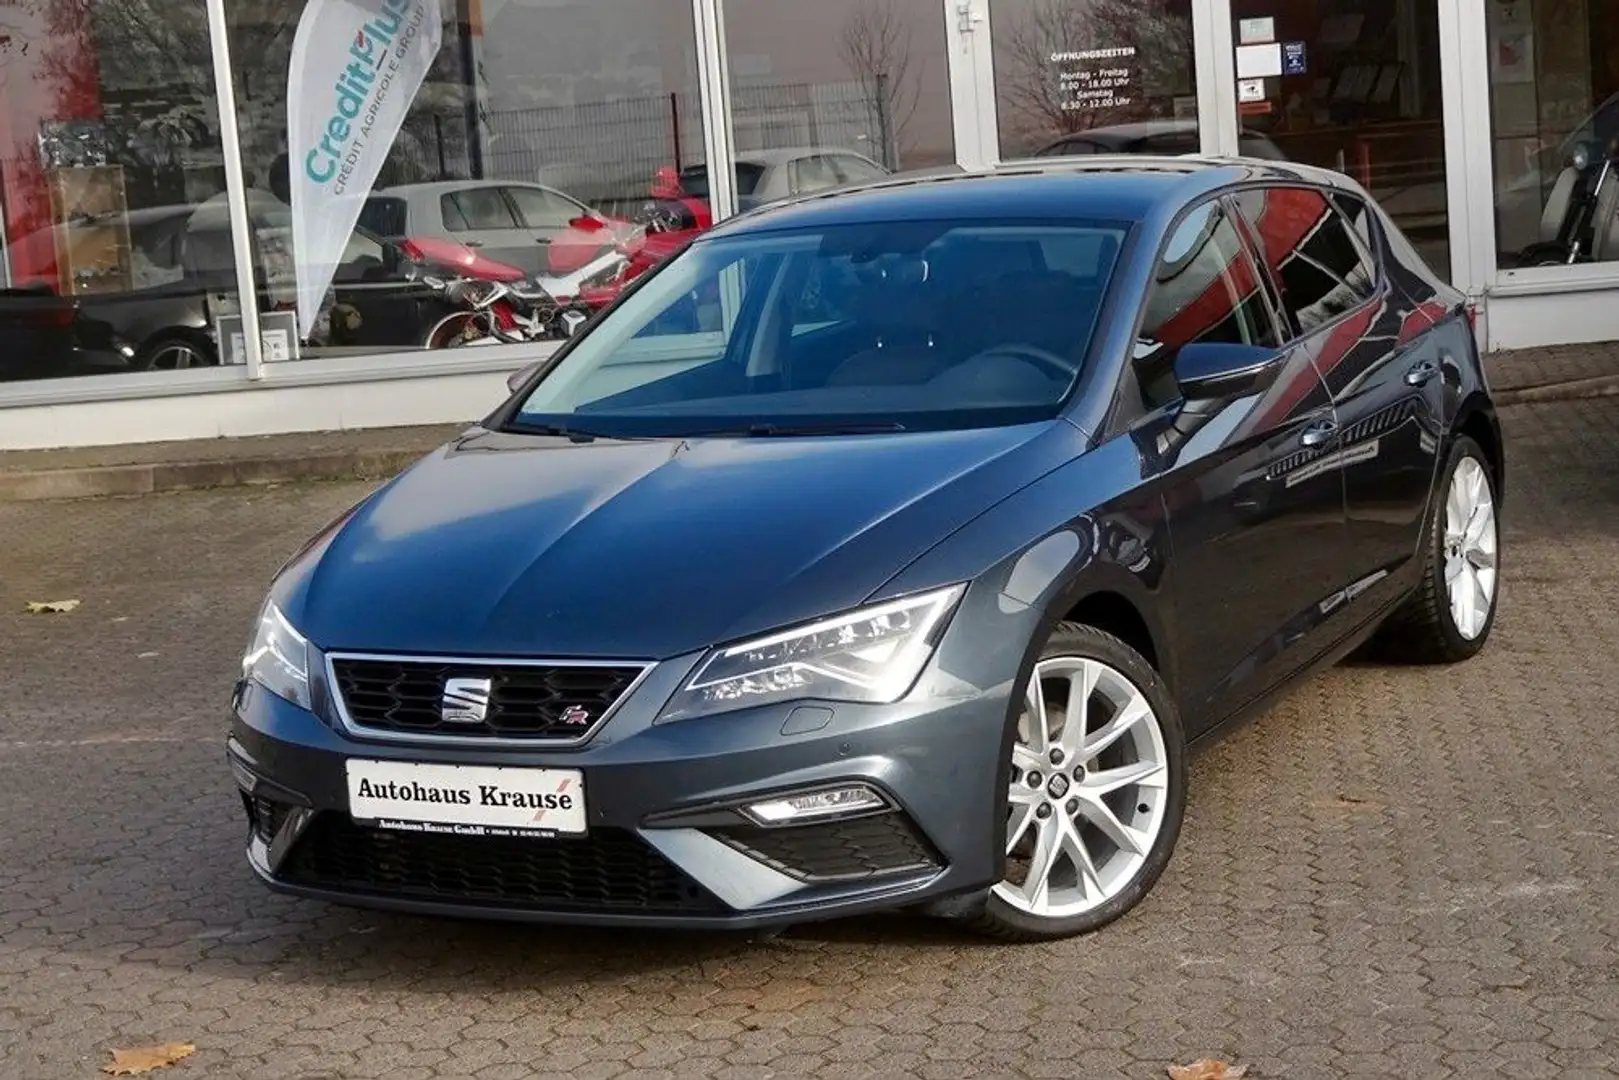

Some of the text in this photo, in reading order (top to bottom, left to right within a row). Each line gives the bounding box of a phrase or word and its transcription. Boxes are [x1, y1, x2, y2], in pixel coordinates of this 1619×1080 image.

[1050, 47, 1135, 62] ÖFFNUNGSZEITEN
[1060, 71, 1091, 80] Montag
[1099, 68, 1128, 77] Freitag
[1113, 78, 1130, 87] Uhr
[361, 60, 399, 138] AGRICOLE
[1077, 89, 1113, 99] Samstag
[1115, 97, 1131, 106] Uhr
[358, 778, 573, 810] Autohaus Krause
[379, 819, 423, 831] Autohaus
